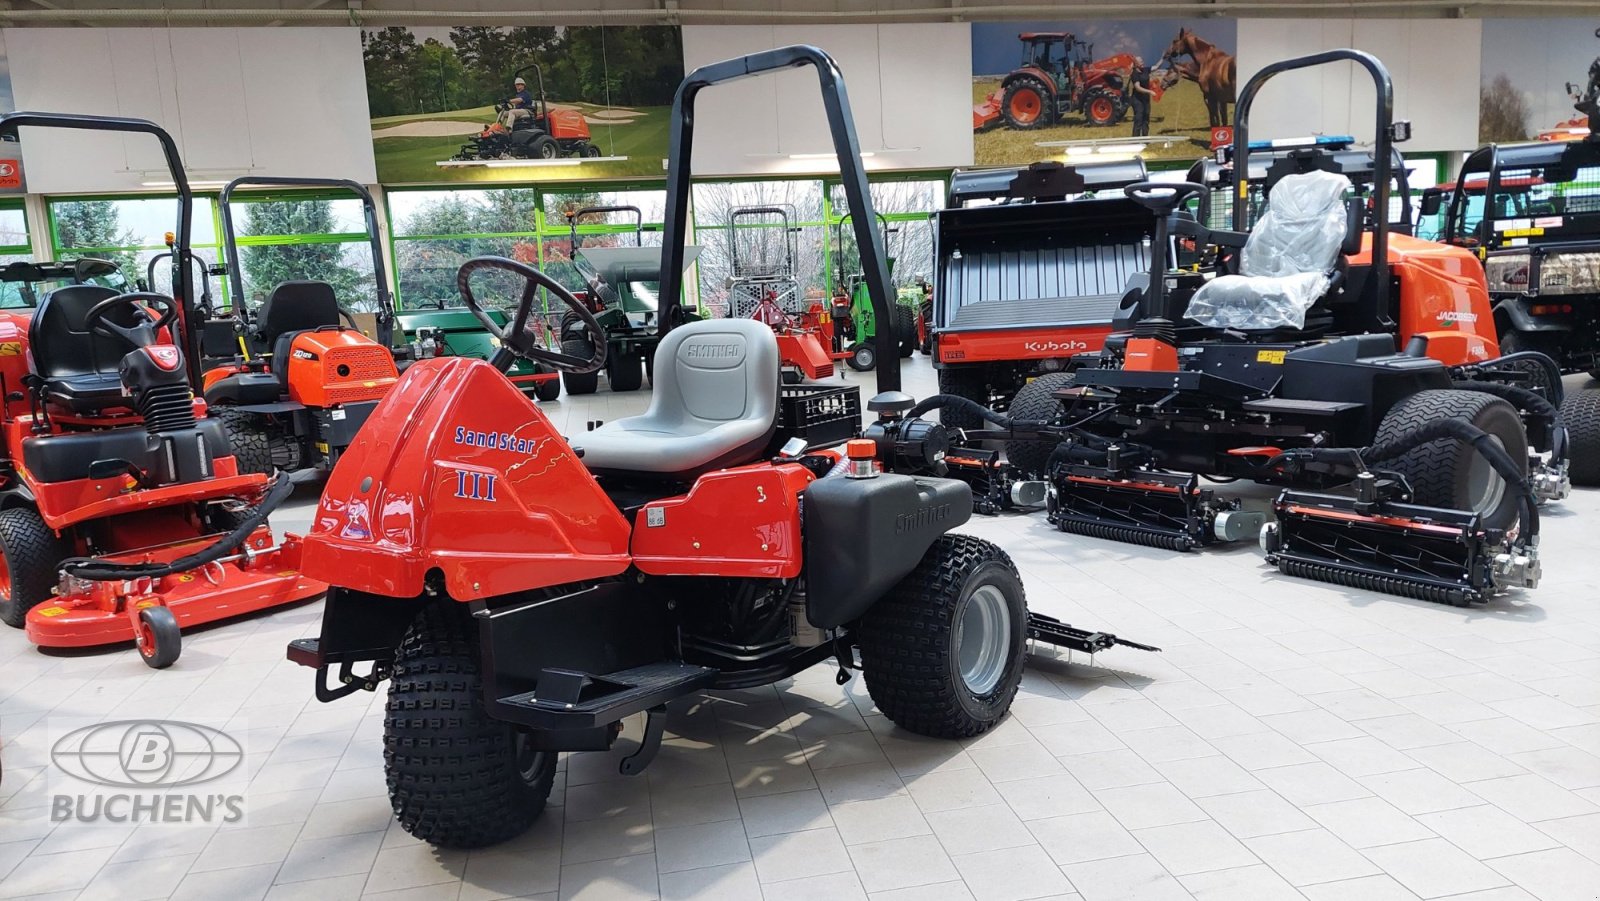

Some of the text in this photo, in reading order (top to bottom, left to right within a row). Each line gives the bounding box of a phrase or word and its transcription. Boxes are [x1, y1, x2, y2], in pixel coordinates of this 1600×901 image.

[1436, 311, 1478, 323] JACOBSEN
[687, 344, 740, 358] SMITHCO
[1024, 340, 1087, 351] Kubota
[454, 470, 498, 502] III
